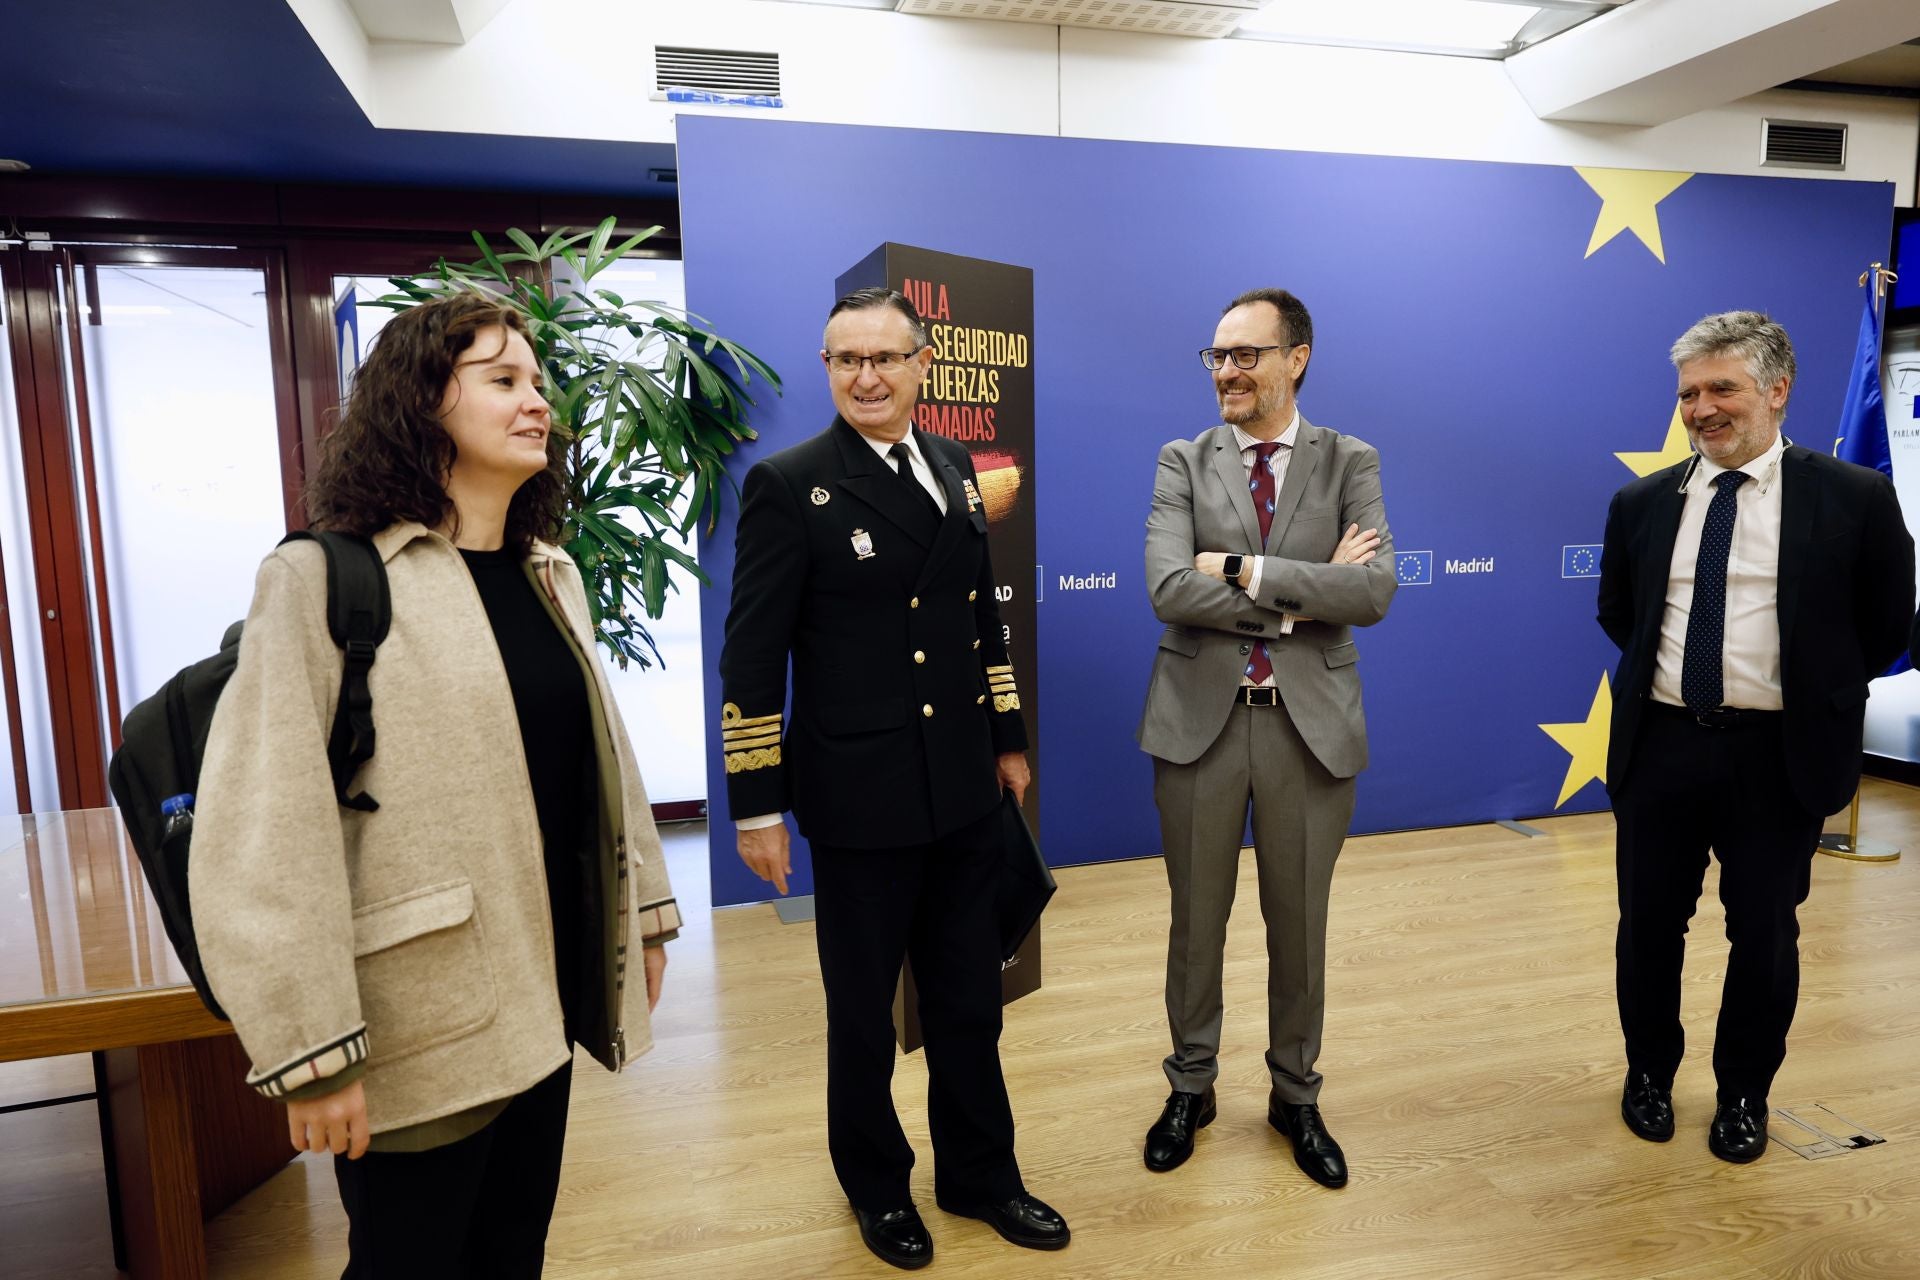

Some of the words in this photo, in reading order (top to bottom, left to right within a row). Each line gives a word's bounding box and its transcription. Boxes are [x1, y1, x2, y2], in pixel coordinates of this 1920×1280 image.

[903, 278, 951, 321] AULA
[931, 323, 1028, 368] SEGURIDAD
[922, 364, 1000, 404] FUERZAS
[1059, 572, 1116, 591] Madrid
[1445, 557, 1494, 574] Madrid
